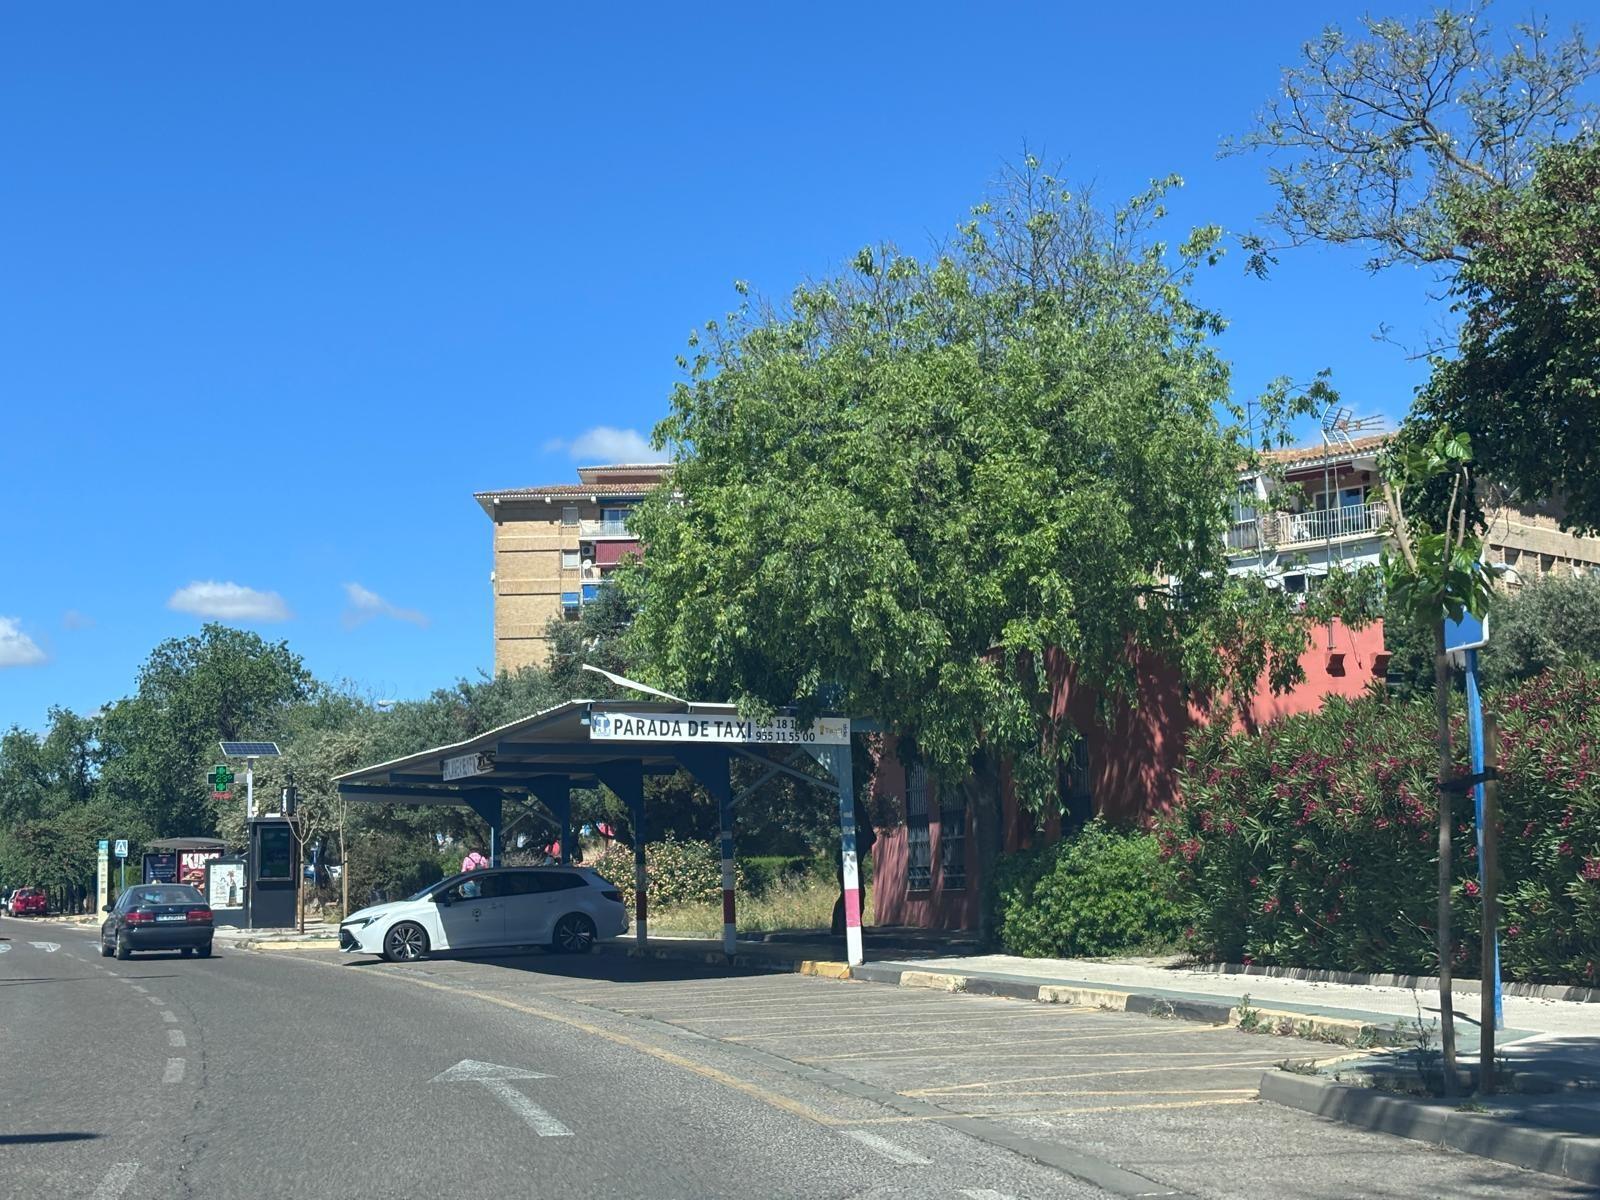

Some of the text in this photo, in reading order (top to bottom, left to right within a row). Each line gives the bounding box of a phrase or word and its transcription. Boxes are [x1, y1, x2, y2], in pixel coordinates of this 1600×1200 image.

[614, 718, 752, 739] PARADA DE TAXI
[776, 719, 788, 729] 18
[755, 731, 816, 742] 955 11 55 00
